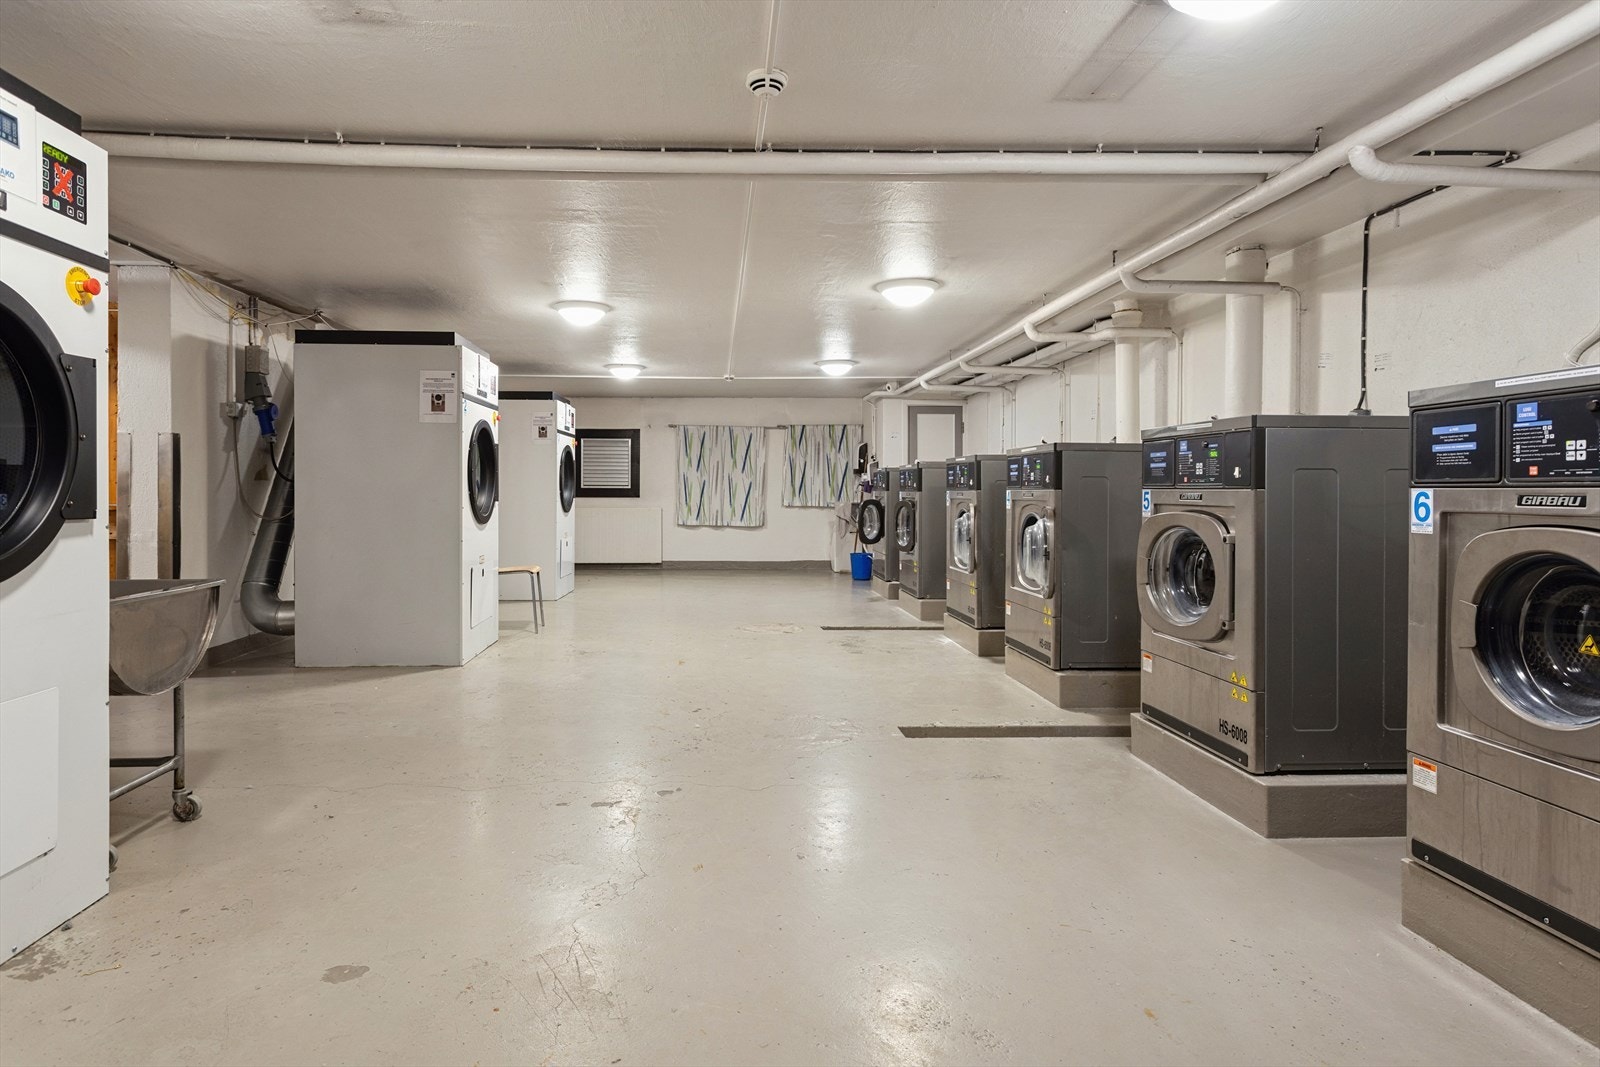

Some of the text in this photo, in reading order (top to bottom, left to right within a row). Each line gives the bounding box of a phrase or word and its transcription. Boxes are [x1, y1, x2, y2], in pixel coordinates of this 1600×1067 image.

[1143, 491, 1150, 510] 5
[1413, 490, 1431, 523] 6
[1521, 495, 1582, 506] GIRBAU
[1218, 718, 1248, 744] HS-6008
